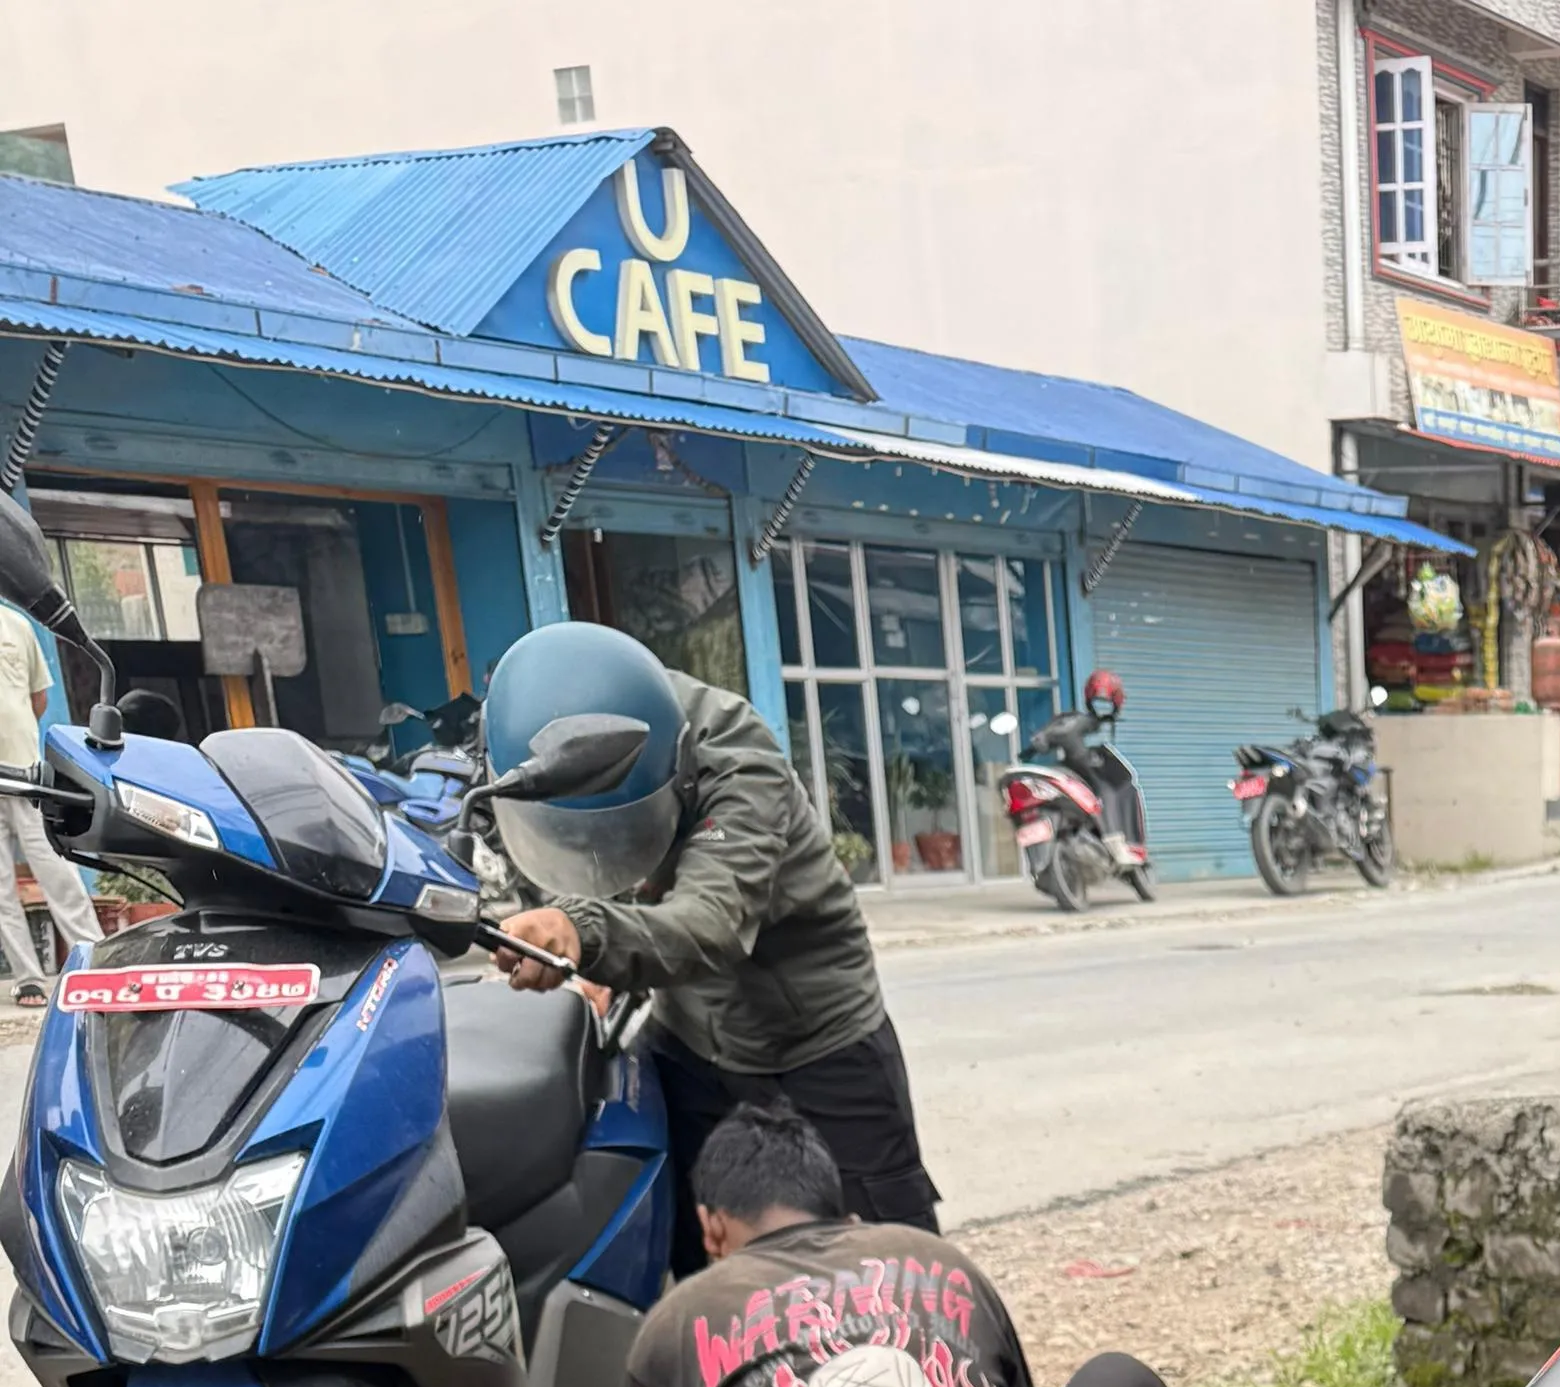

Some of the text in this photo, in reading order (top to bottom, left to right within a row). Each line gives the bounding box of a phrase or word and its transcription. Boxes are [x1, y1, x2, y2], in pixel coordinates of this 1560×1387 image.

[614, 159, 690, 262] U
[547, 248, 770, 383] CAFE
[173, 943, 229, 960] TVS
